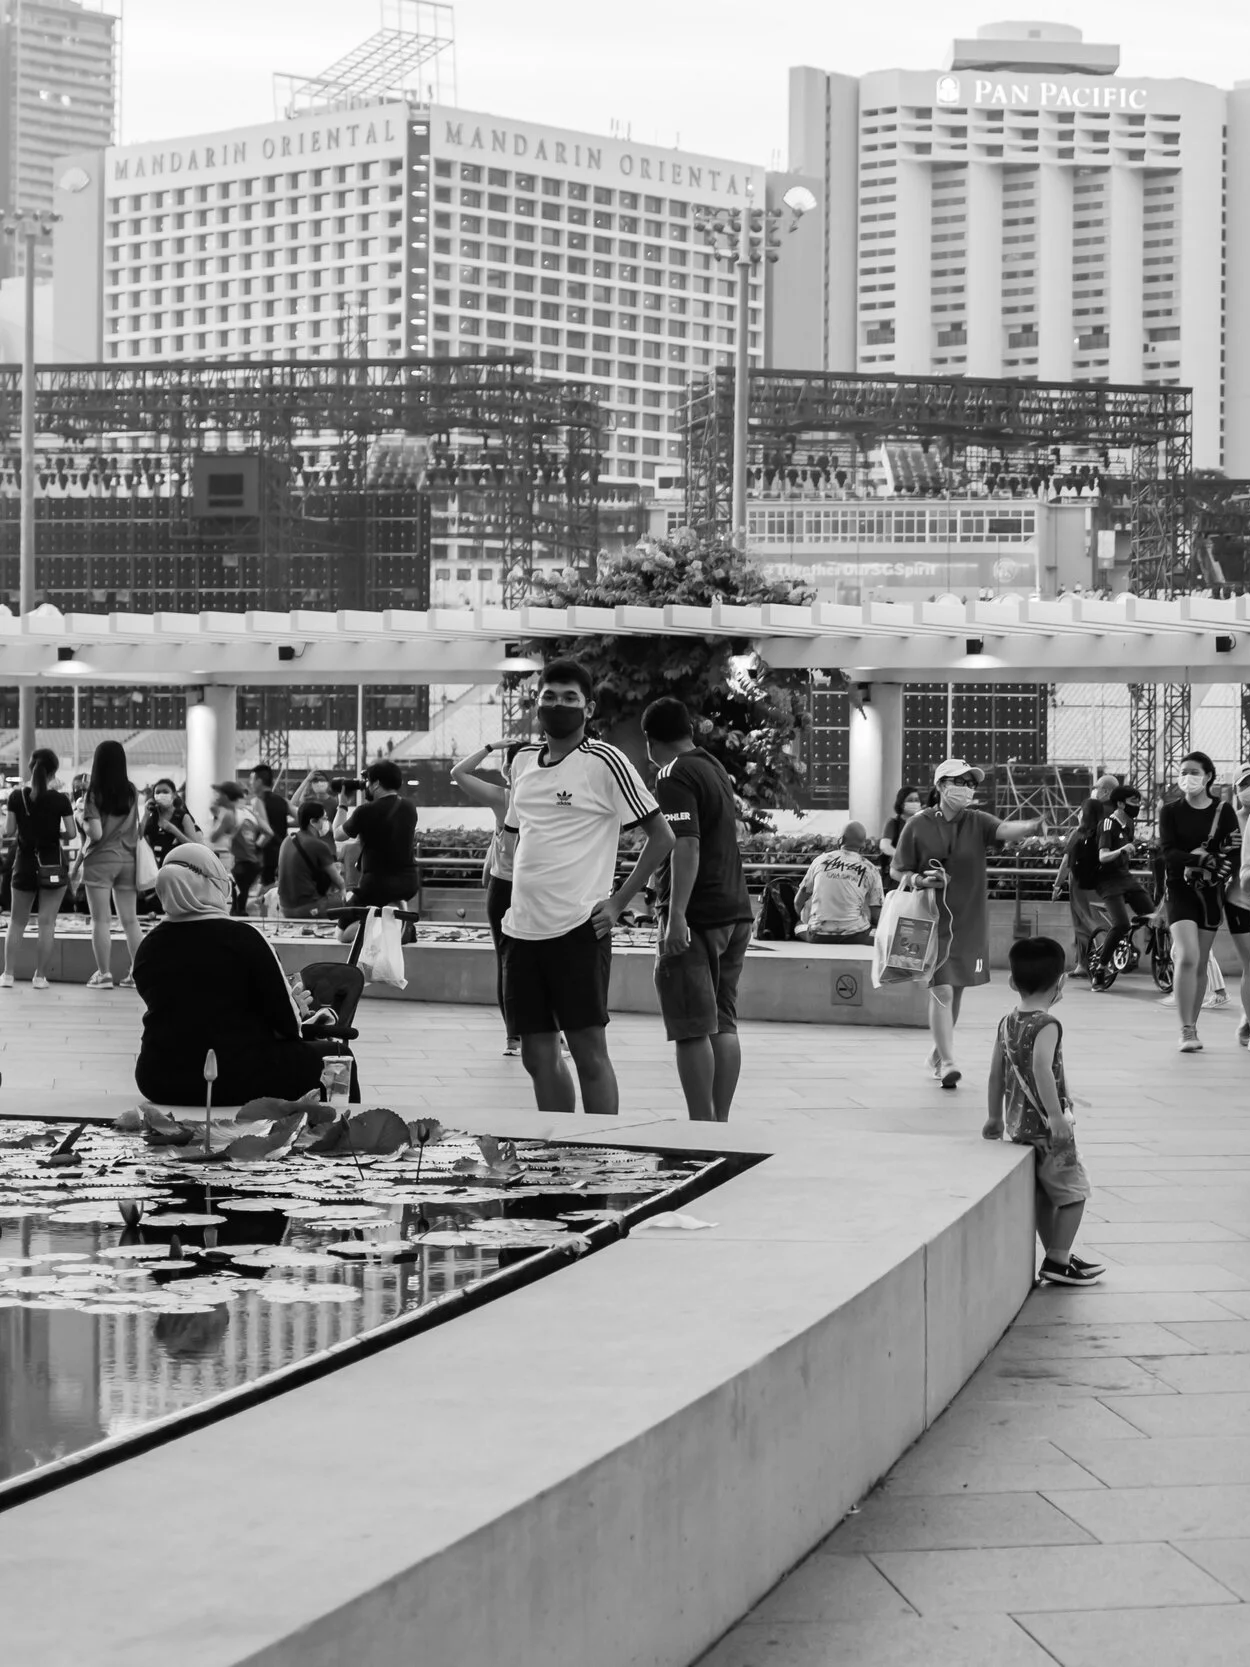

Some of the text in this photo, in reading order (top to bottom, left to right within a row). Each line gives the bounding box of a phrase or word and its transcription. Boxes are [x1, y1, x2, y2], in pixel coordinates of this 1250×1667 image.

[974, 79, 1147, 109] PAN PACIFIC
[114, 119, 395, 181] MANDARIN ORIENTAL
[444, 120, 756, 198] MANDARIN ORIENTAL
[663, 812, 691, 821] OHLER
